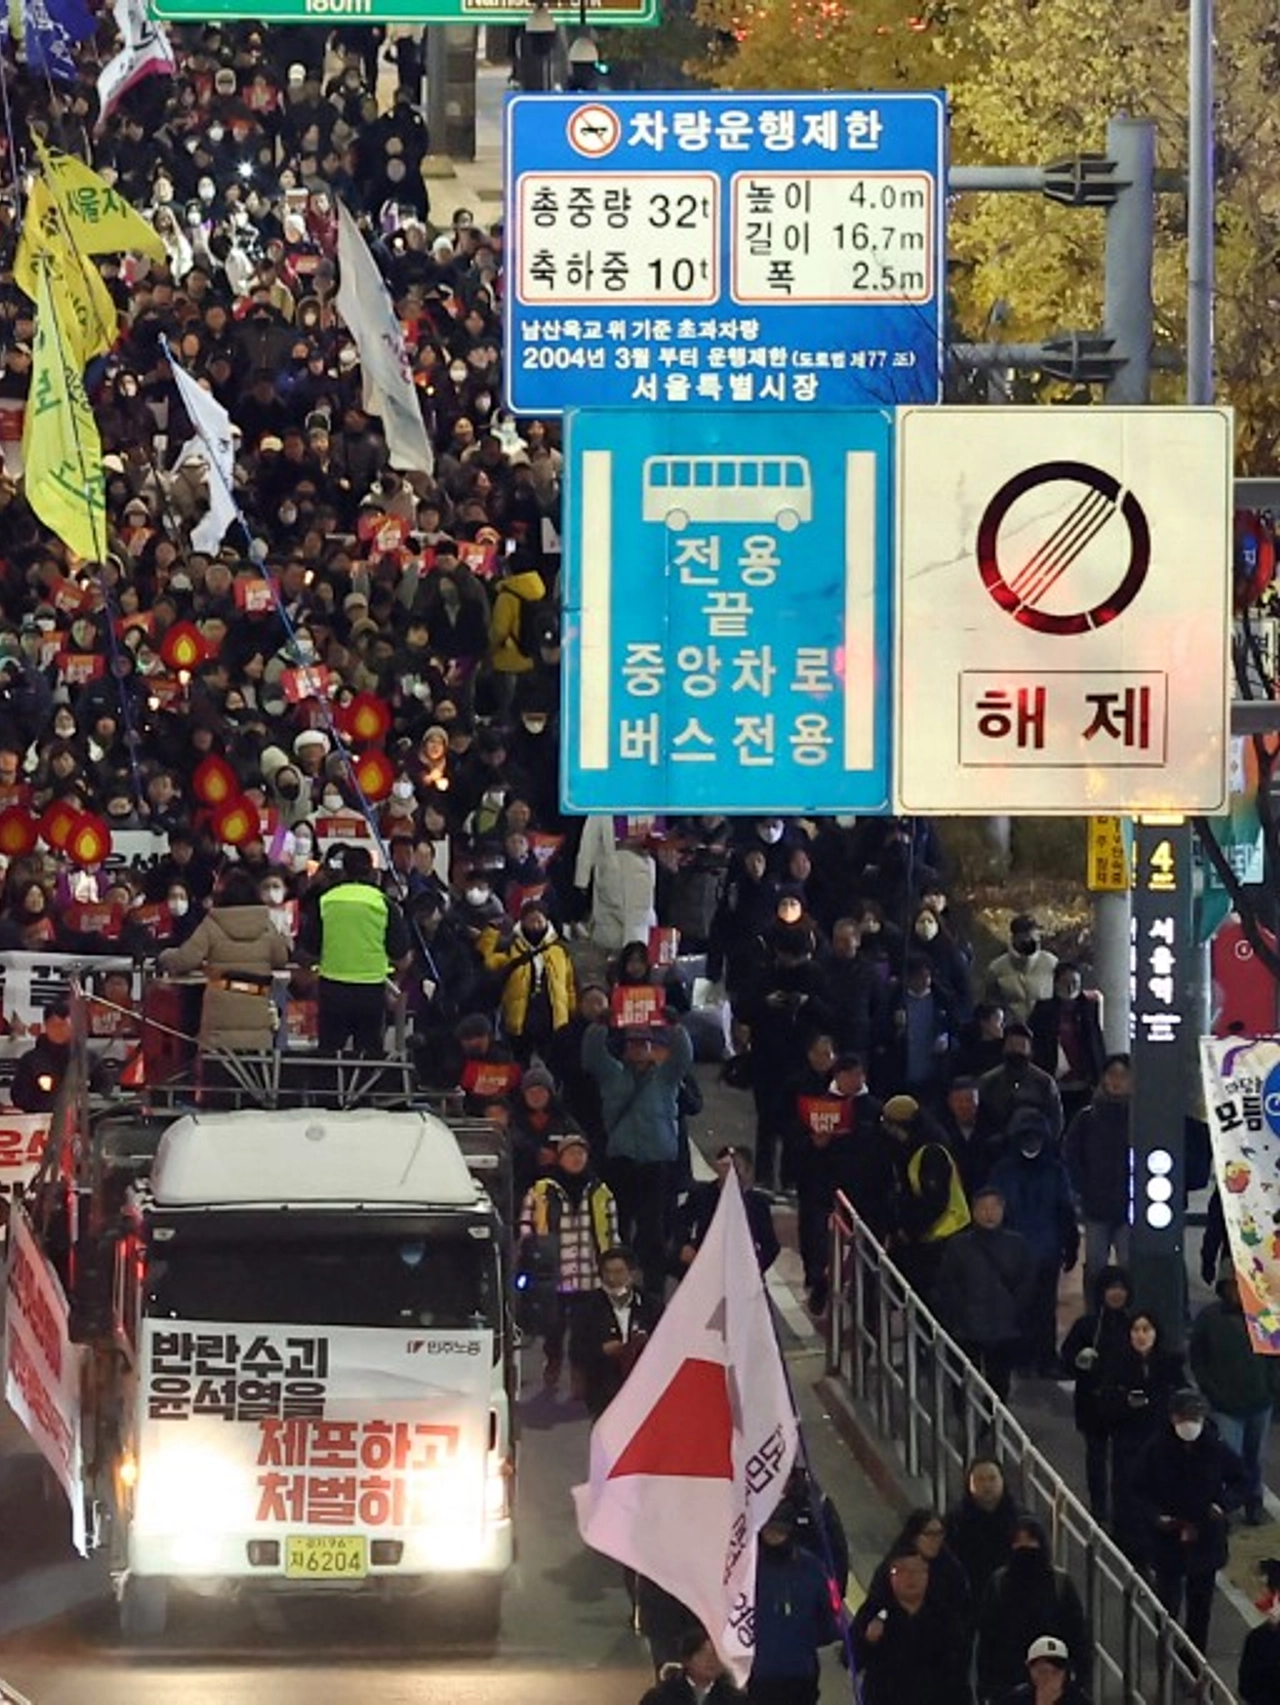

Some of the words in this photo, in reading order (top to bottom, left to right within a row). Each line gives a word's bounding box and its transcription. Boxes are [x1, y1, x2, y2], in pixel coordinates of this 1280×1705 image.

[627, 110, 883, 151] 차량운행제한
[530, 187, 631, 229] 총중량
[648, 194, 709, 229] 32t
[746, 180, 810, 213] 높이
[849, 181, 924, 209] 4.0m
[745, 222, 810, 256] 길이
[833, 222, 924, 251] 16.7m
[529, 250, 630, 291] 축하중
[648, 256, 709, 291] 10t
[767, 260, 796, 296] 폭
[852, 262, 924, 290] 2.5m
[632, 319, 672, 340] 기준
[523, 347, 606, 369] 2004년
[614, 347, 651, 369] 3월
[658, 347, 699, 369] 부터
[707, 347, 787, 369] 운행제한
[632, 372, 819, 402] 서울특별시장
[673, 534, 782, 587] 전용
[701, 591, 754, 637] 끝
[621, 642, 834, 698] 중앙차로
[975, 686, 1151, 749] 해제
[619, 712, 834, 767] 버스전용
[1150, 840, 1174, 874] 4
[150, 1331, 330, 1380] 반란수괴
[148, 1376, 327, 1422] 윤석열을
